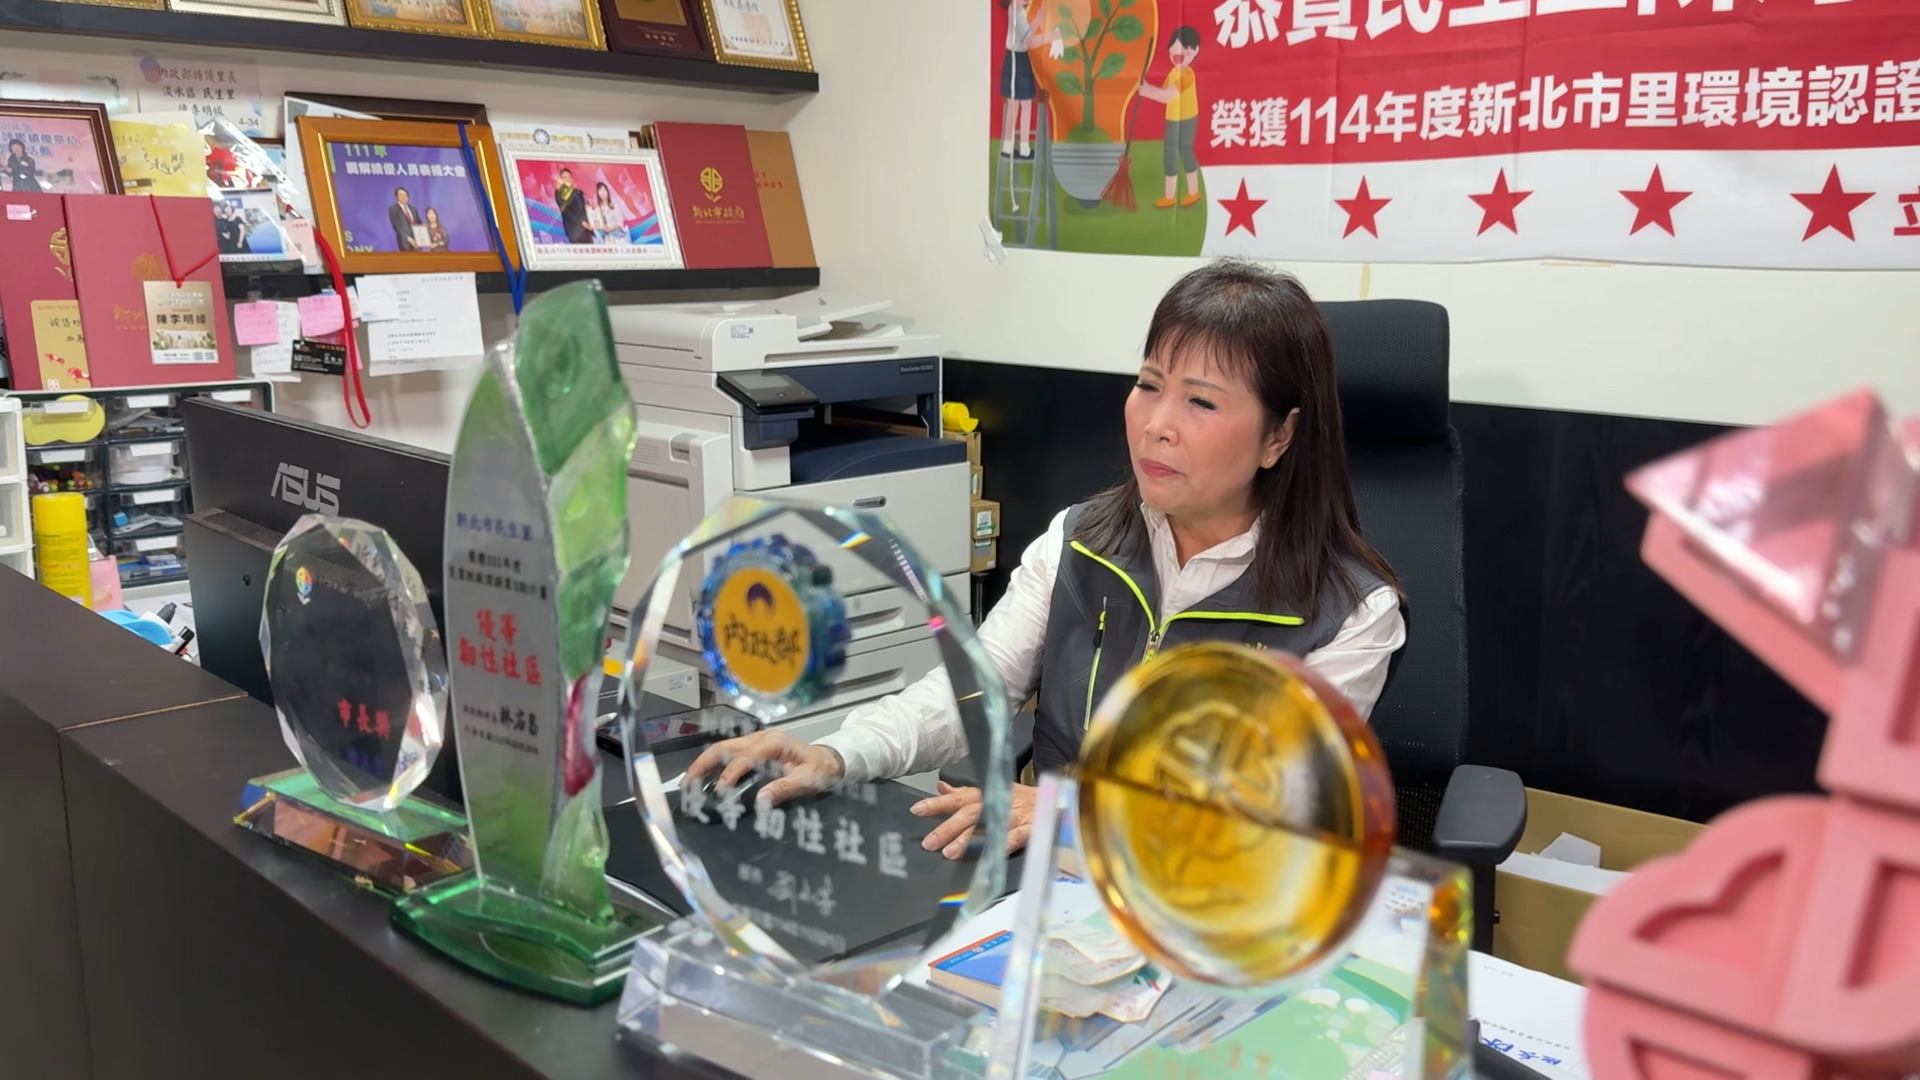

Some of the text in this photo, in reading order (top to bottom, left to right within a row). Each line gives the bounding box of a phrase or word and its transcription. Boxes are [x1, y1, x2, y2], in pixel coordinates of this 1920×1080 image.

[1210, 60, 1920, 148] 榮獲114年度新北市里環境認證
[692, 205, 745, 219] 新北市政府
[270, 462, 341, 518] ASUS
[477, 608, 518, 646] 優等
[723, 611, 802, 669] 內政部
[458, 636, 543, 687] 韌性社區
[338, 698, 390, 740] 市長獎
